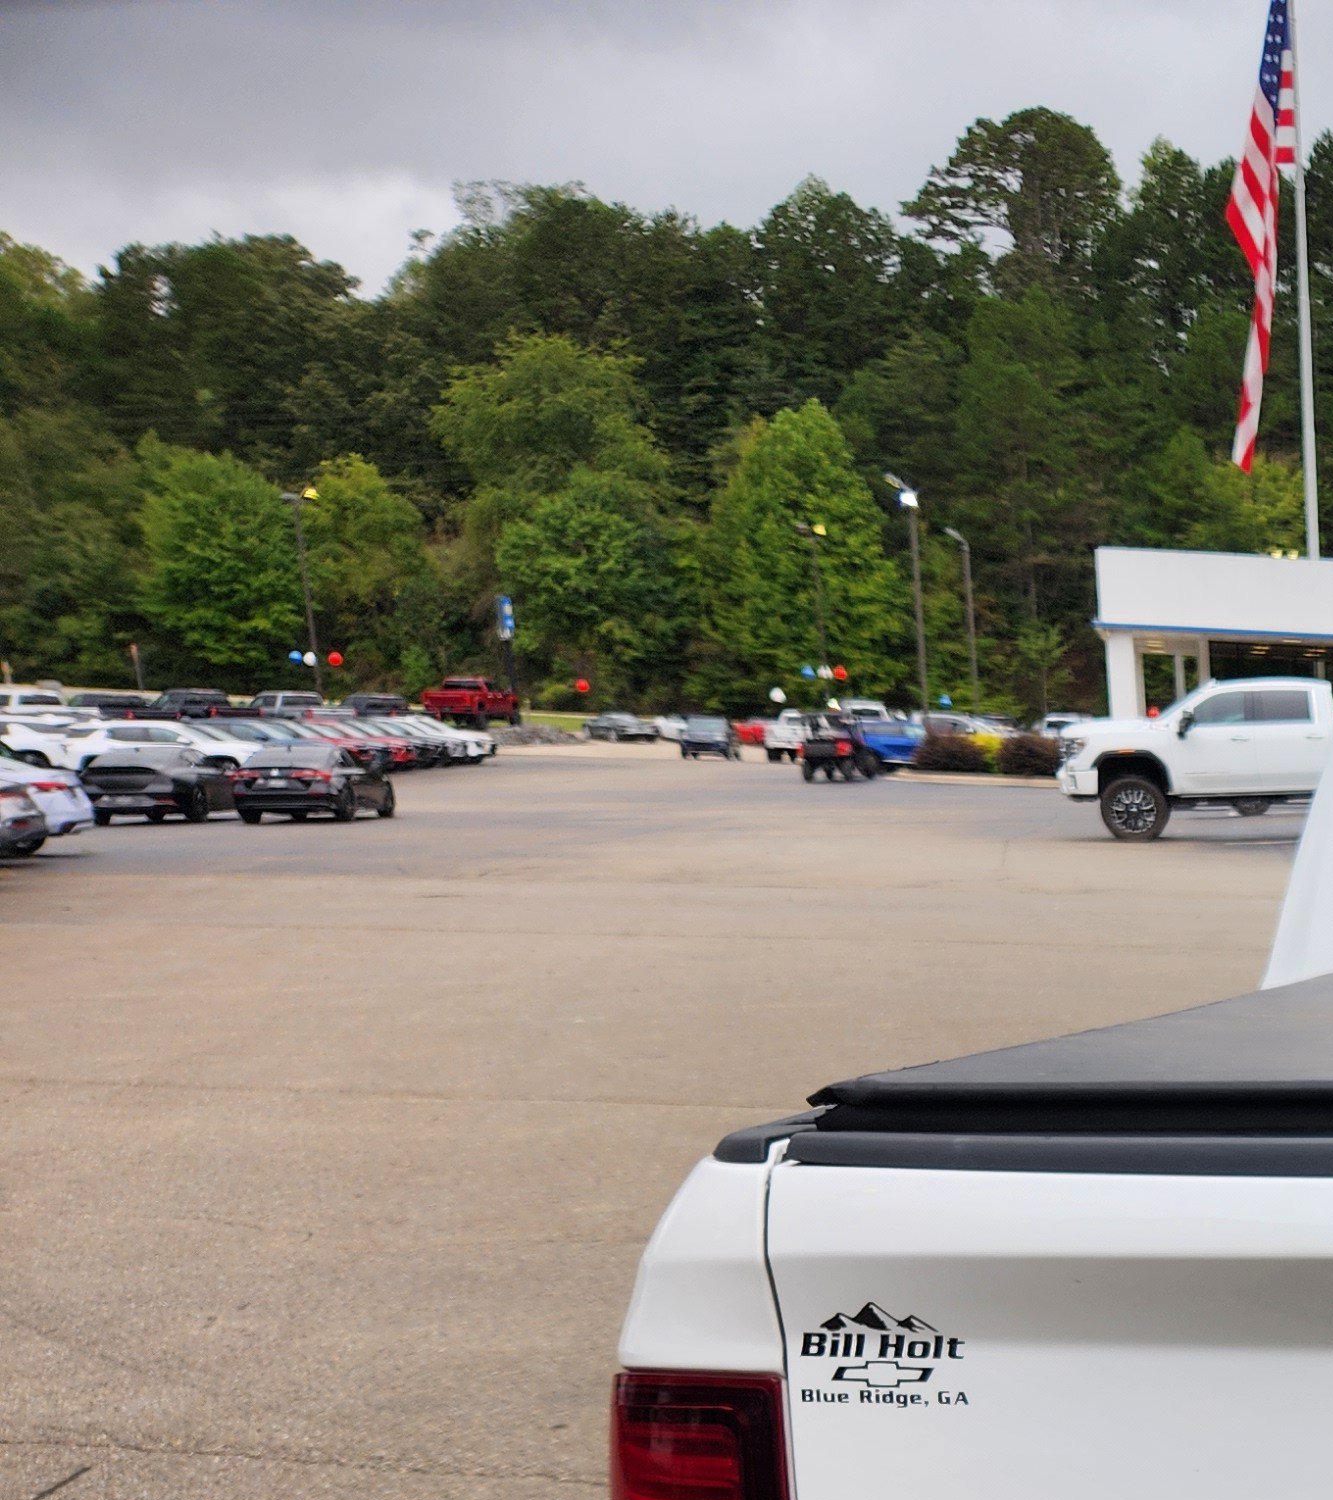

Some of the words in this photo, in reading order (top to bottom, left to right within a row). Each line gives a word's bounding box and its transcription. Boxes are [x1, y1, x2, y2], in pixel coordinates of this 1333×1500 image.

[800, 1332, 866, 1358] Bill
[878, 1334, 966, 1360] Holt
[801, 1388, 850, 1404] Blue
[859, 1389, 929, 1408] Ridge,
[937, 1391, 969, 1405] GA
